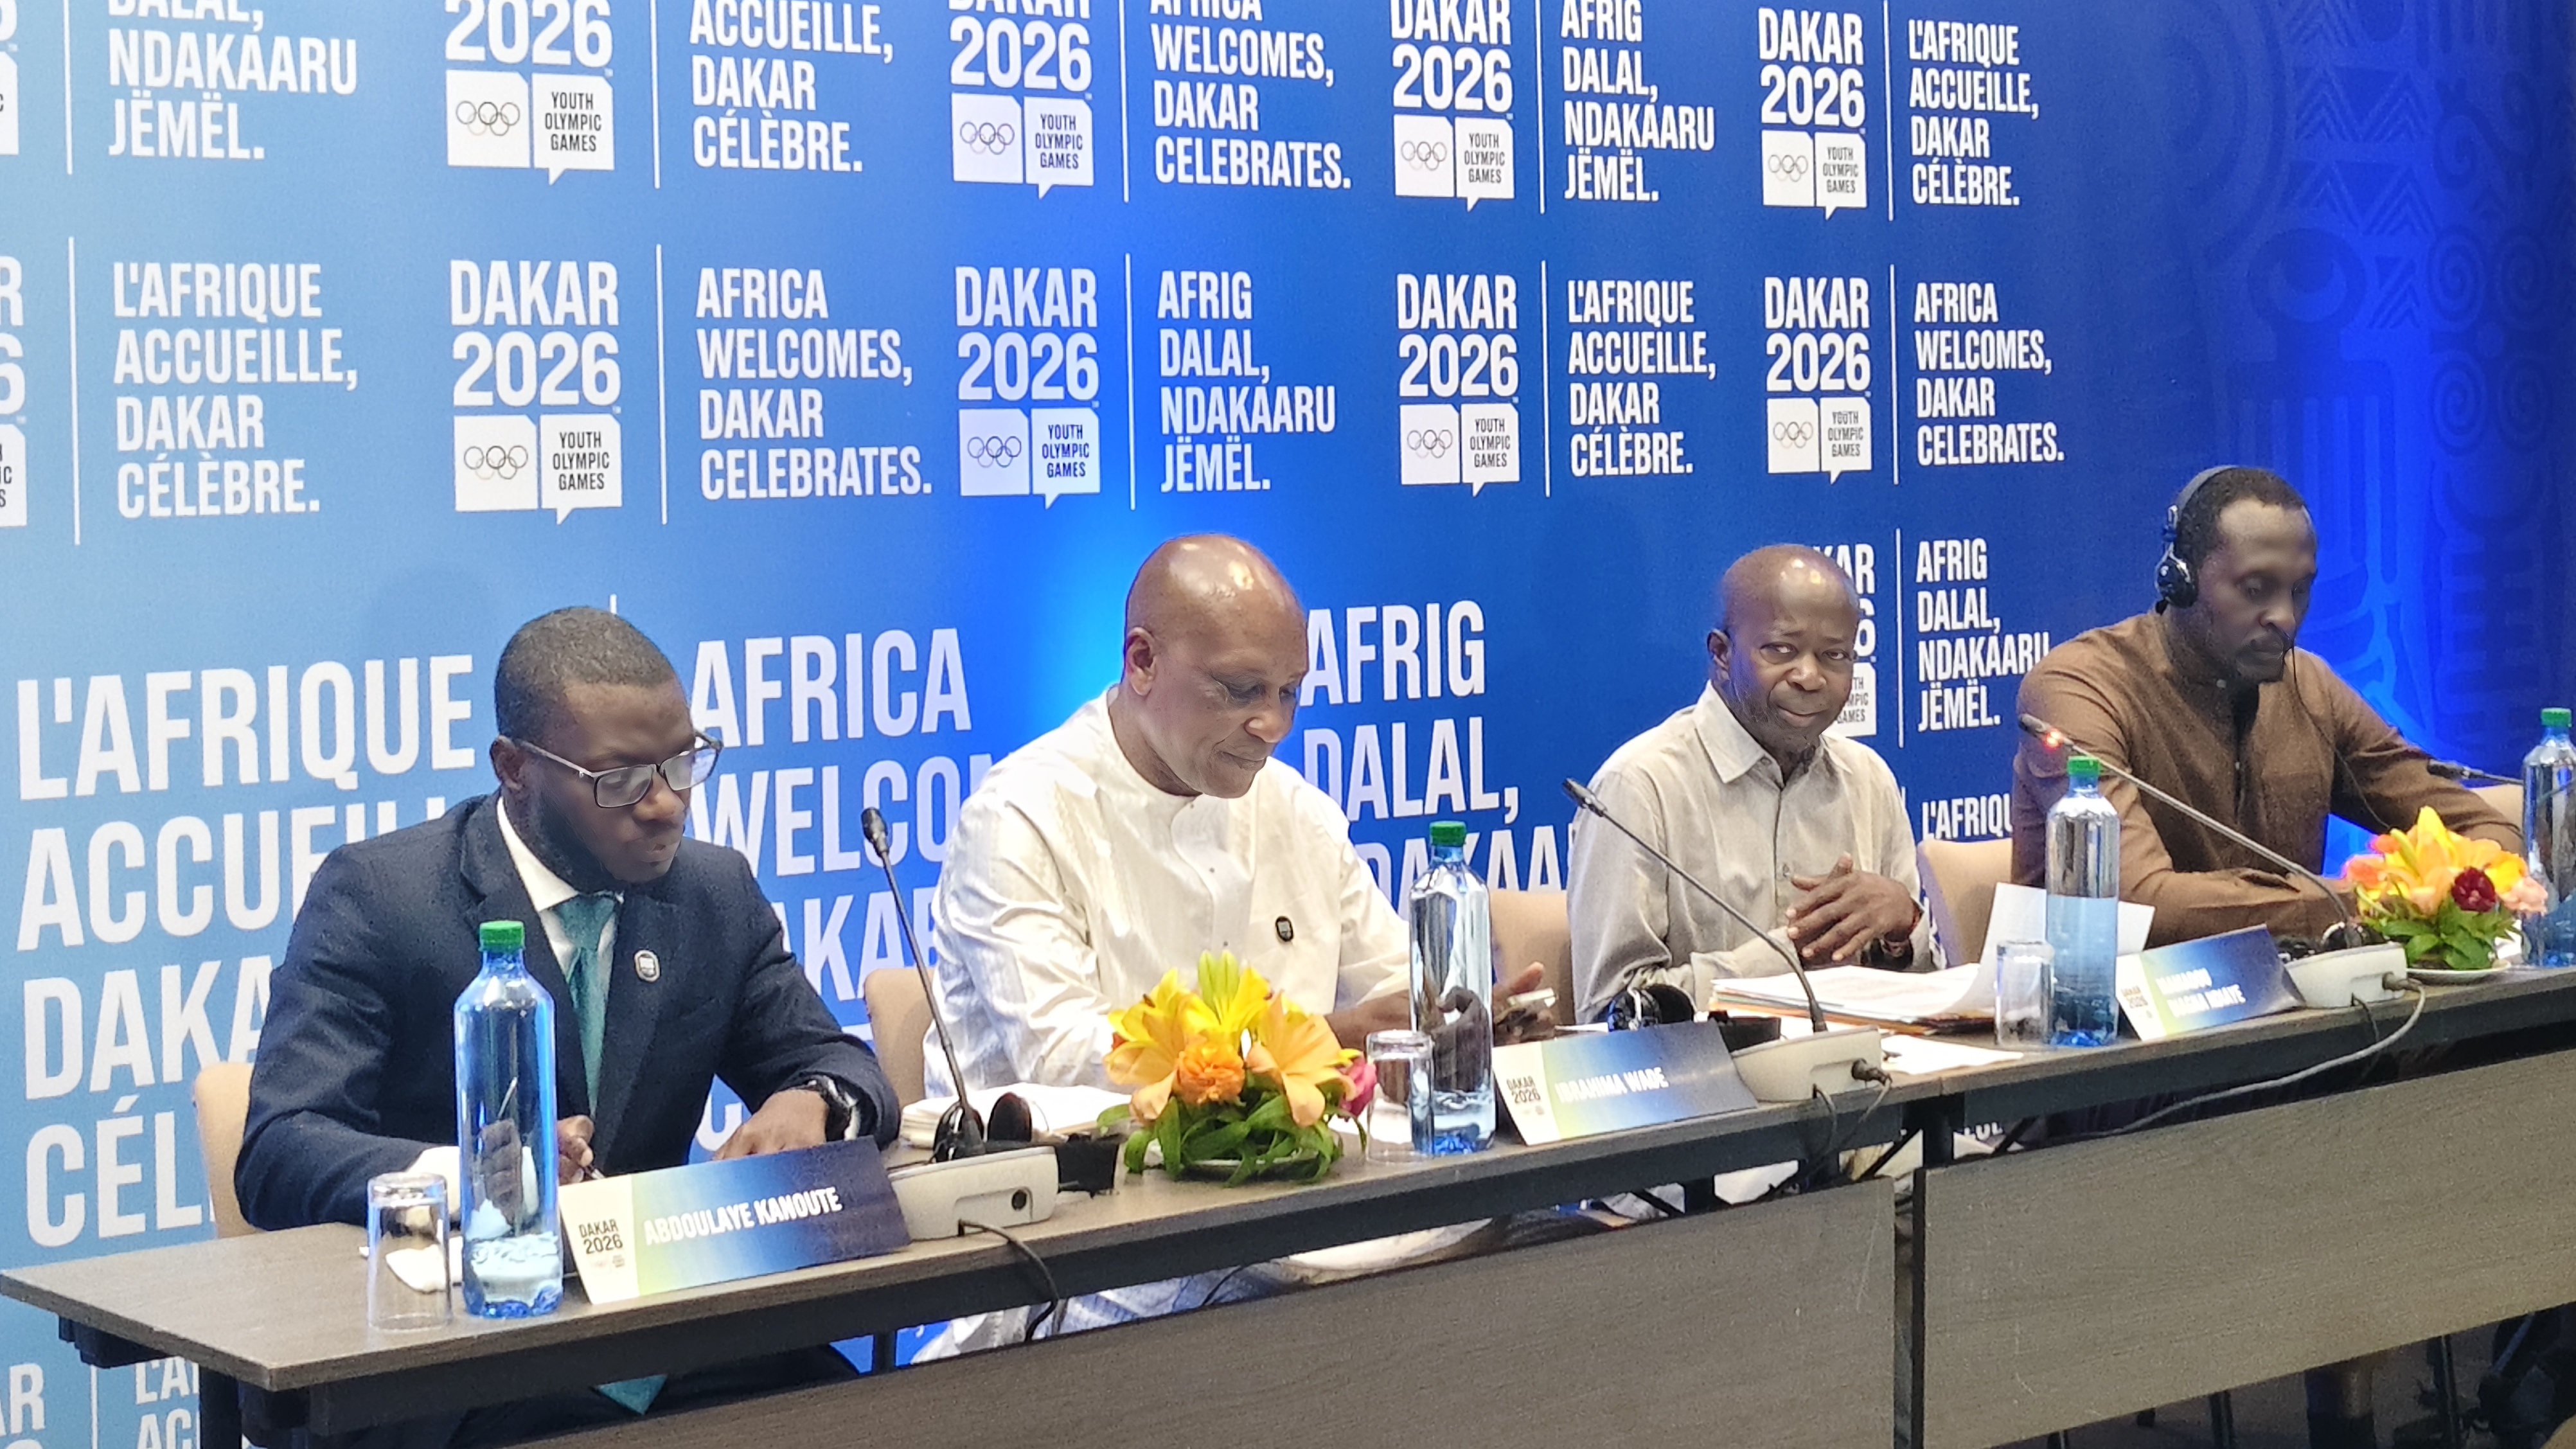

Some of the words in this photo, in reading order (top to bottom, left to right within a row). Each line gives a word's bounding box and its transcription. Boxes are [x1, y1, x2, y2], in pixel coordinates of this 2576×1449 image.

[445, 0, 612, 67] 2026
[690, 0, 893, 63] ACCUEILLE,
[1391, 0, 1511, 44] DAKAR
[1561, 0, 1642, 41] AFRIG
[1759, 8, 1863, 64] DAKAR
[1909, 20, 2019, 68] L'AFRIQUE
[109, 29, 356, 96] NDAKAARU
[950, 16, 1091, 91] 2026
[1151, 24, 1333, 87] WELCOMES,
[1393, 44, 1512, 112] 2026
[1563, 47, 1657, 102] DALAL,
[552, 92, 593, 109] YOUTH
[693, 55, 815, 110] DAKAR
[1155, 80, 1257, 130] DAKAR
[1761, 65, 1865, 127] 2026
[1910, 68, 2038, 119] ACCUEILLE,
[109, 89, 264, 159] JËMËL.
[545, 113, 601, 131] OLYMPIC
[551, 134, 596, 152] GAMES
[694, 109, 862, 171] CÉLÈBRE.
[1036, 132, 1083, 150] OLYMPIC
[1040, 114, 1076, 130] YOUTH
[1469, 133, 1499, 148] YOUTH
[1565, 101, 1714, 151] NDAKAARU
[1912, 116, 1989, 157] DAKAR
[1040, 152, 1078, 169] GAMES
[1156, 136, 1351, 188] CELEBRATES.
[1464, 150, 1505, 166] OLYMPIC
[1469, 168, 1501, 183] GAMES
[1565, 147, 1658, 200] JËMËL.
[1823, 163, 1858, 177] OLYMPIC
[1827, 147, 1853, 160] YOUTH
[1827, 179, 1855, 193] GAMES
[1913, 157, 2019, 205] CÉLÈBRE.
[114, 263, 321, 323] L'AFRIQUE
[450, 260, 618, 325] DAKAR
[697, 268, 828, 319] AFRICA
[956, 267, 1097, 326] DAKAR
[1158, 271, 1251, 319] AFRIG
[1398, 274, 1516, 328] DAKAR
[1568, 281, 1694, 327] L'AFRIQUE
[1765, 278, 1869, 328] DAKAR
[1915, 283, 1998, 322] AFRICA
[114, 329, 357, 390] ACCUEILLE,
[453, 332, 620, 406] 2026
[697, 329, 911, 386] WELCOMES,
[959, 332, 1098, 400] 2026
[1160, 329, 1269, 384] DALAL,
[1399, 334, 1518, 396] 2026
[1569, 332, 1715, 379] ACCUEILLE,
[1767, 333, 1870, 391] 2026
[1915, 330, 2051, 374] WELCOMES,
[700, 389, 823, 439] DAKAR
[1162, 386, 1335, 434] NDAKAARU
[1570, 382, 1659, 425] DAKAR
[1833, 411, 1858, 425] YOUTH
[1917, 378, 1994, 417] DAKAR
[117, 395, 263, 450] DAKAR
[560, 432, 601, 449] YOUTH
[1049, 424, 1083, 440] YOUTH
[1470, 436, 1510, 450] OLYMPIC
[1475, 418, 1505, 432] YOUTH
[1828, 427, 1863, 441] OLYMPIC
[1918, 422, 2064, 465] CELEBRATES.
[553, 452, 609, 470] OLYMPIC
[702, 447, 931, 500] CELEBRATES.
[1042, 443, 1089, 459] OLYMPIC
[1047, 462, 1085, 478] GAMES
[1162, 436, 1270, 492] JËMËL.
[1475, 452, 1507, 468] GAMES
[1571, 426, 1692, 476] CÉLÈBRE.
[1832, 443, 1860, 457] GAMES
[118, 452, 319, 518] CÉLÈBRE.
[559, 473, 604, 490] GAMES
[1917, 538, 1987, 582] AFRIG
[1918, 587, 2000, 634] DALAL,
[1299, 601, 1484, 706] AFRIG
[687, 629, 970, 748] AFRICA
[1919, 679, 2000, 731] JËMËL.
[17, 655, 474, 800] L'AFRIQUE
[1302, 717, 1518, 823] DALAL,
[691, 753, 990, 878] WELCO
[1555, 1074, 1627, 1103] IBRAHIMA
[1623, 1067, 1669, 1092] WADE
[578, 1218, 619, 1238] DAKAR
[645, 1202, 755, 1245] ABDOULAYE
[754, 1186, 842, 1225] KANOUTE
[583, 1233, 623, 1254] 2026
